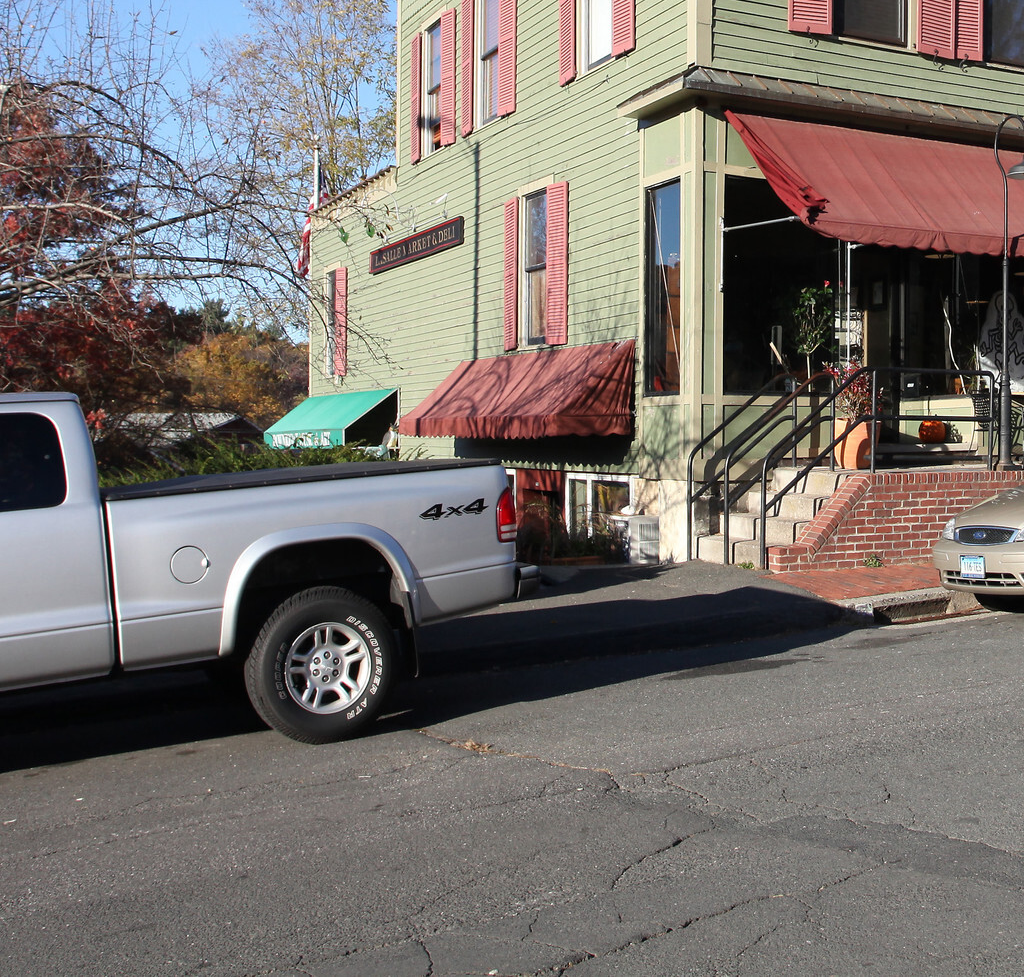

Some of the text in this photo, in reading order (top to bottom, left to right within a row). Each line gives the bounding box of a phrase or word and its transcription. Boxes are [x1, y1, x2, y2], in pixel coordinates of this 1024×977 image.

[375, 247, 401, 267] LSALLE
[432, 232, 438, 246] &
[438, 225, 455, 243] DELI
[419, 498, 488, 520] 4x4
[346, 615, 383, 720] DISCOVERER ATR
